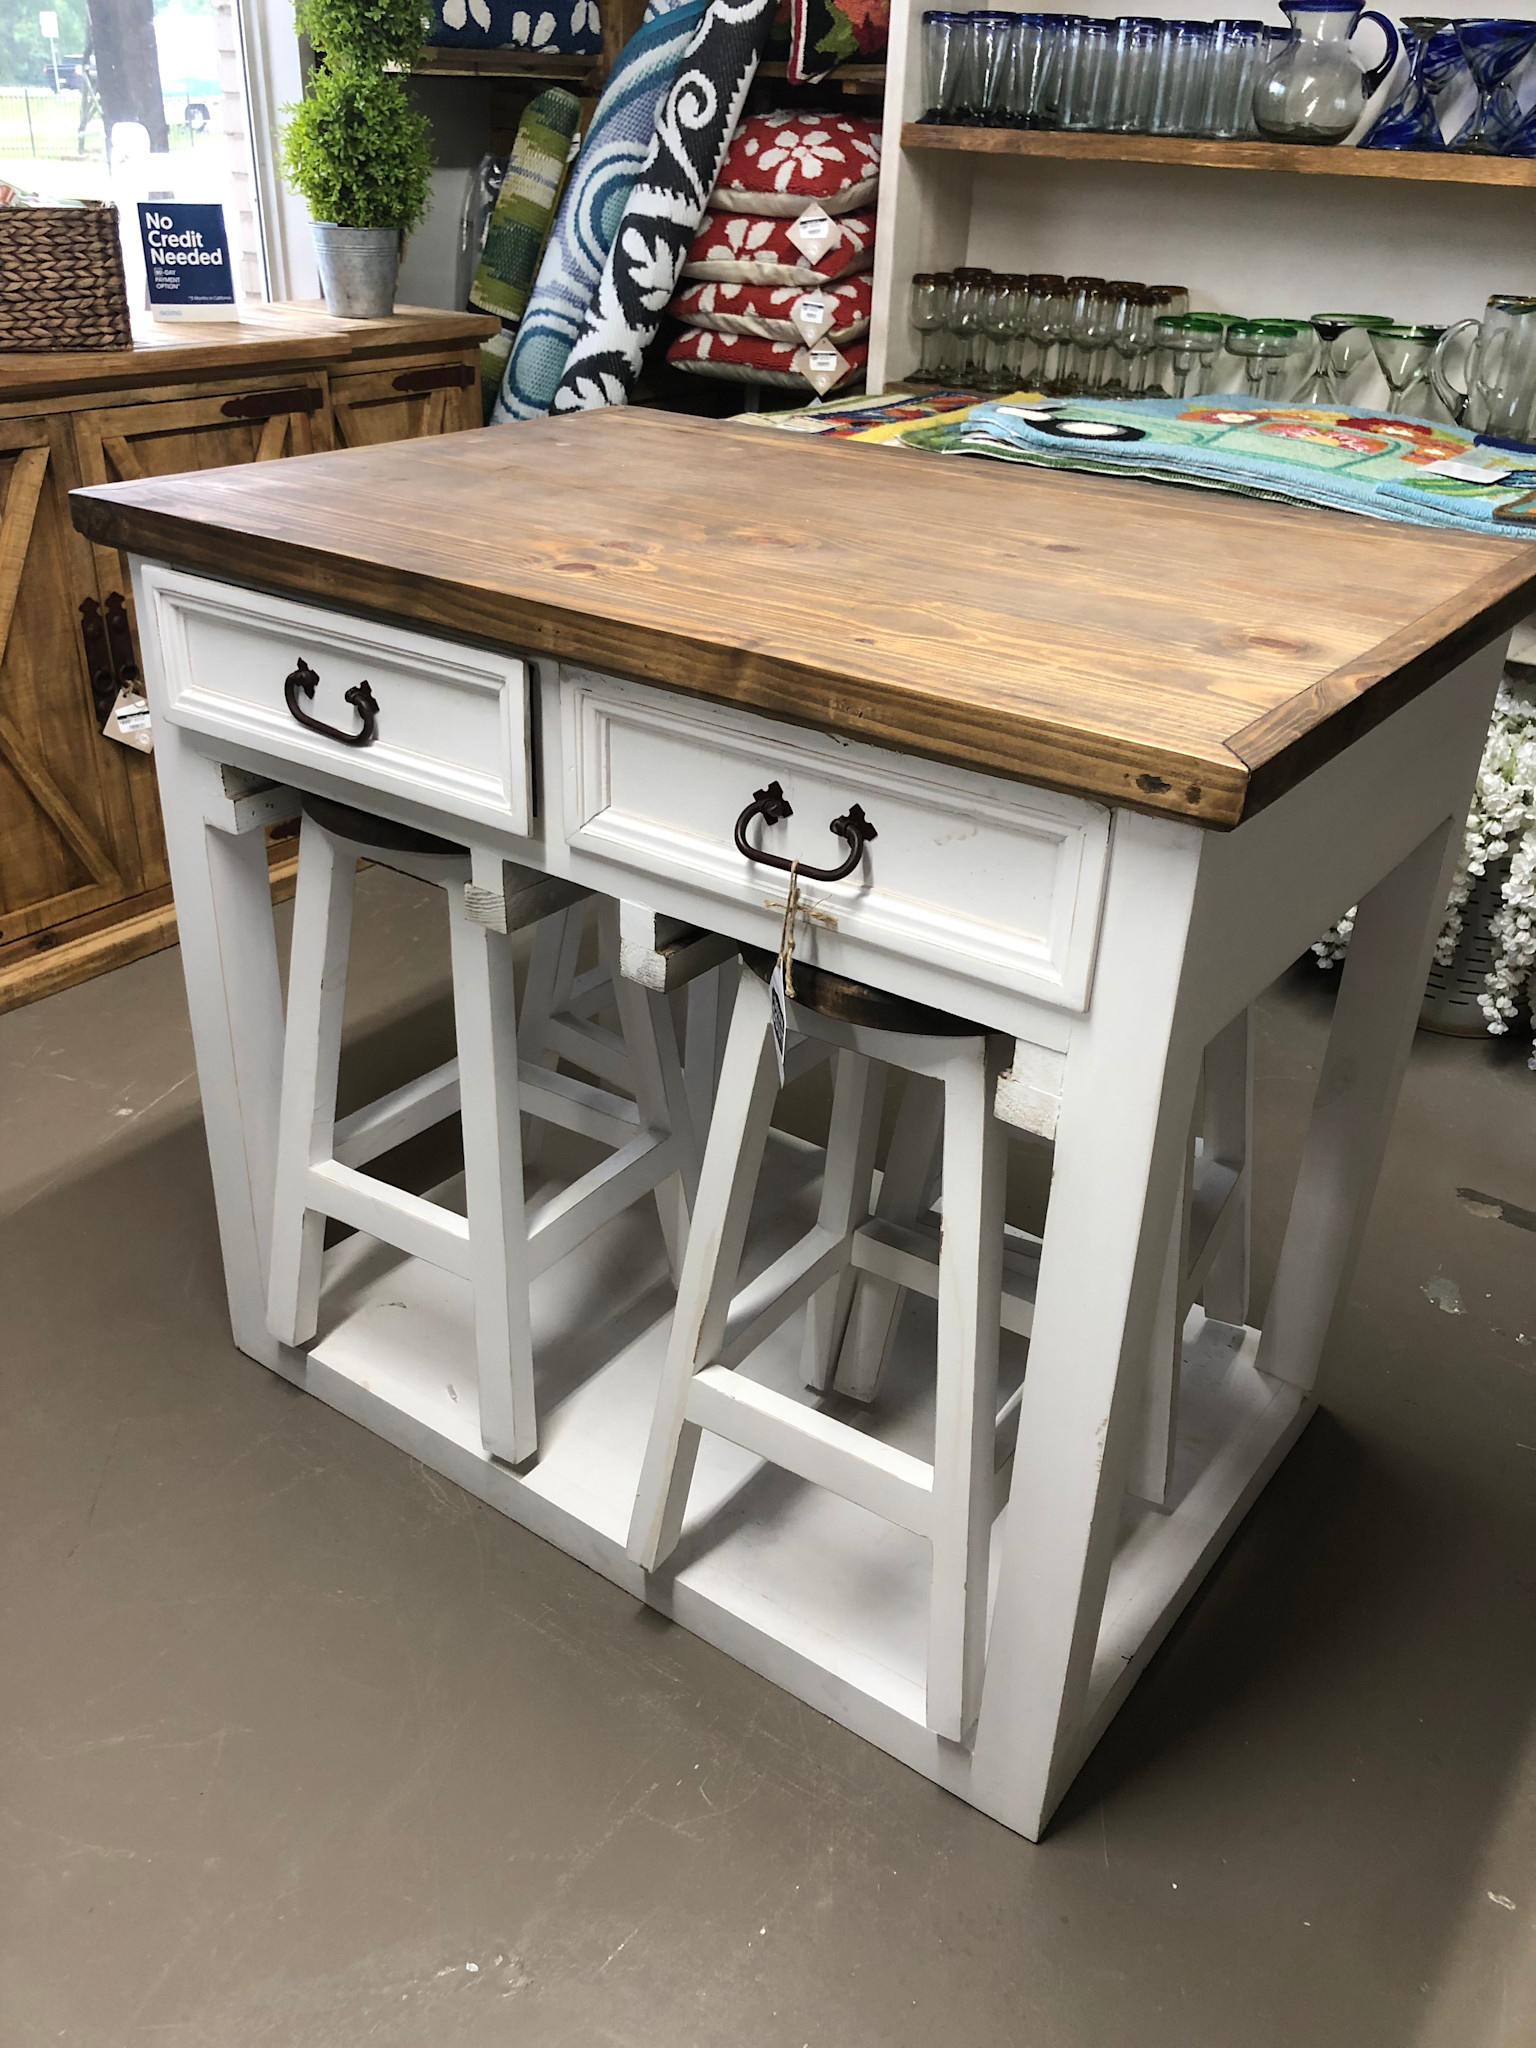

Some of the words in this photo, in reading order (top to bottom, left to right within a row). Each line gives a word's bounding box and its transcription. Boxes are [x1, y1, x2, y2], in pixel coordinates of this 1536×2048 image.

[145, 212, 173, 230] No
[147, 230, 204, 248] Credit
[150, 248, 223, 266] Needed
